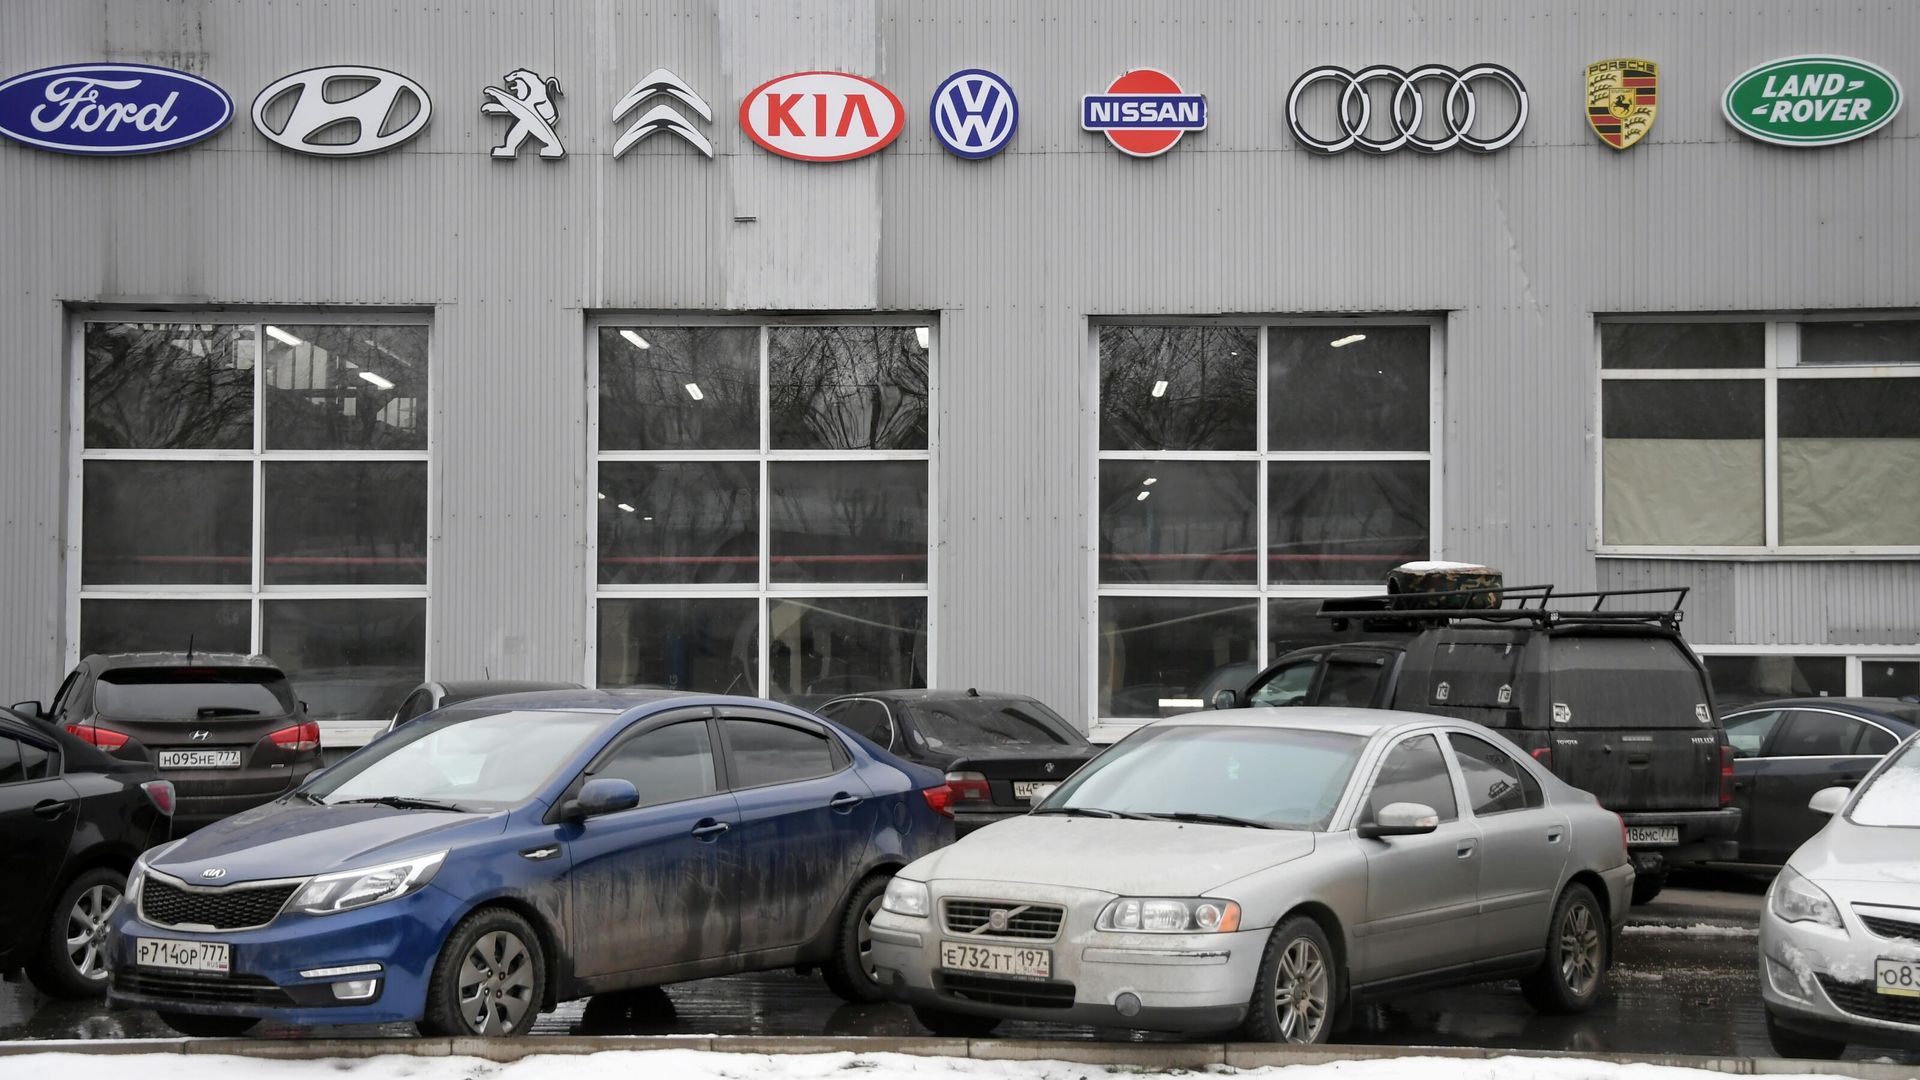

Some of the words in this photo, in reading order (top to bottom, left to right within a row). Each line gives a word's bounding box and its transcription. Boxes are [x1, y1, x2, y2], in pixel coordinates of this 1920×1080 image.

[1589, 61, 1655, 75] PORSCHE
[30, 76, 181, 134] Ford
[1089, 100, 1201, 123] NISSAN
[766, 93, 880, 138] KIA
[218, 751, 237, 762] 777
[1627, 828, 1659, 841] 186МС
[1662, 827, 1675, 838] 777
[202, 868, 219, 877] KIA
[202, 944, 225, 961] 777
[947, 946, 1013, 970] Е732ТТ
[1017, 950, 1044, 967] 197
